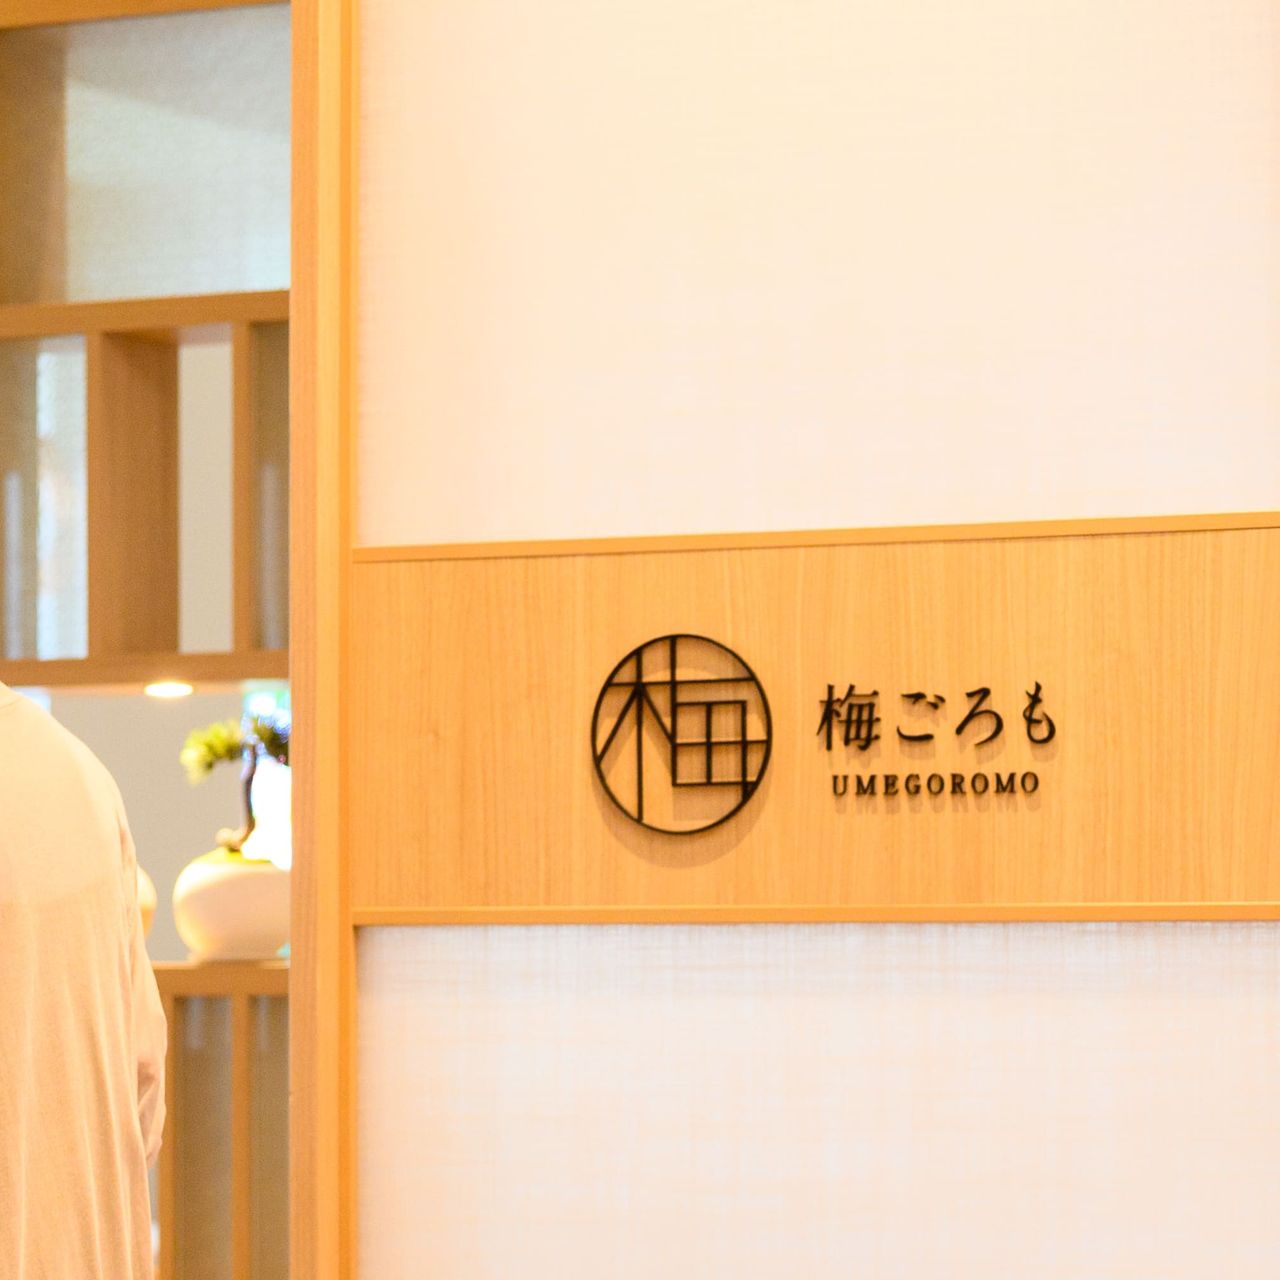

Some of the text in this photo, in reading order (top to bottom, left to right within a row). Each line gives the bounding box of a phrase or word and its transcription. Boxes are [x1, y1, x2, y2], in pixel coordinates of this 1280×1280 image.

[816, 681, 1056, 751] 梅ごろも
[832, 771, 1039, 796] UMEGOROMO
